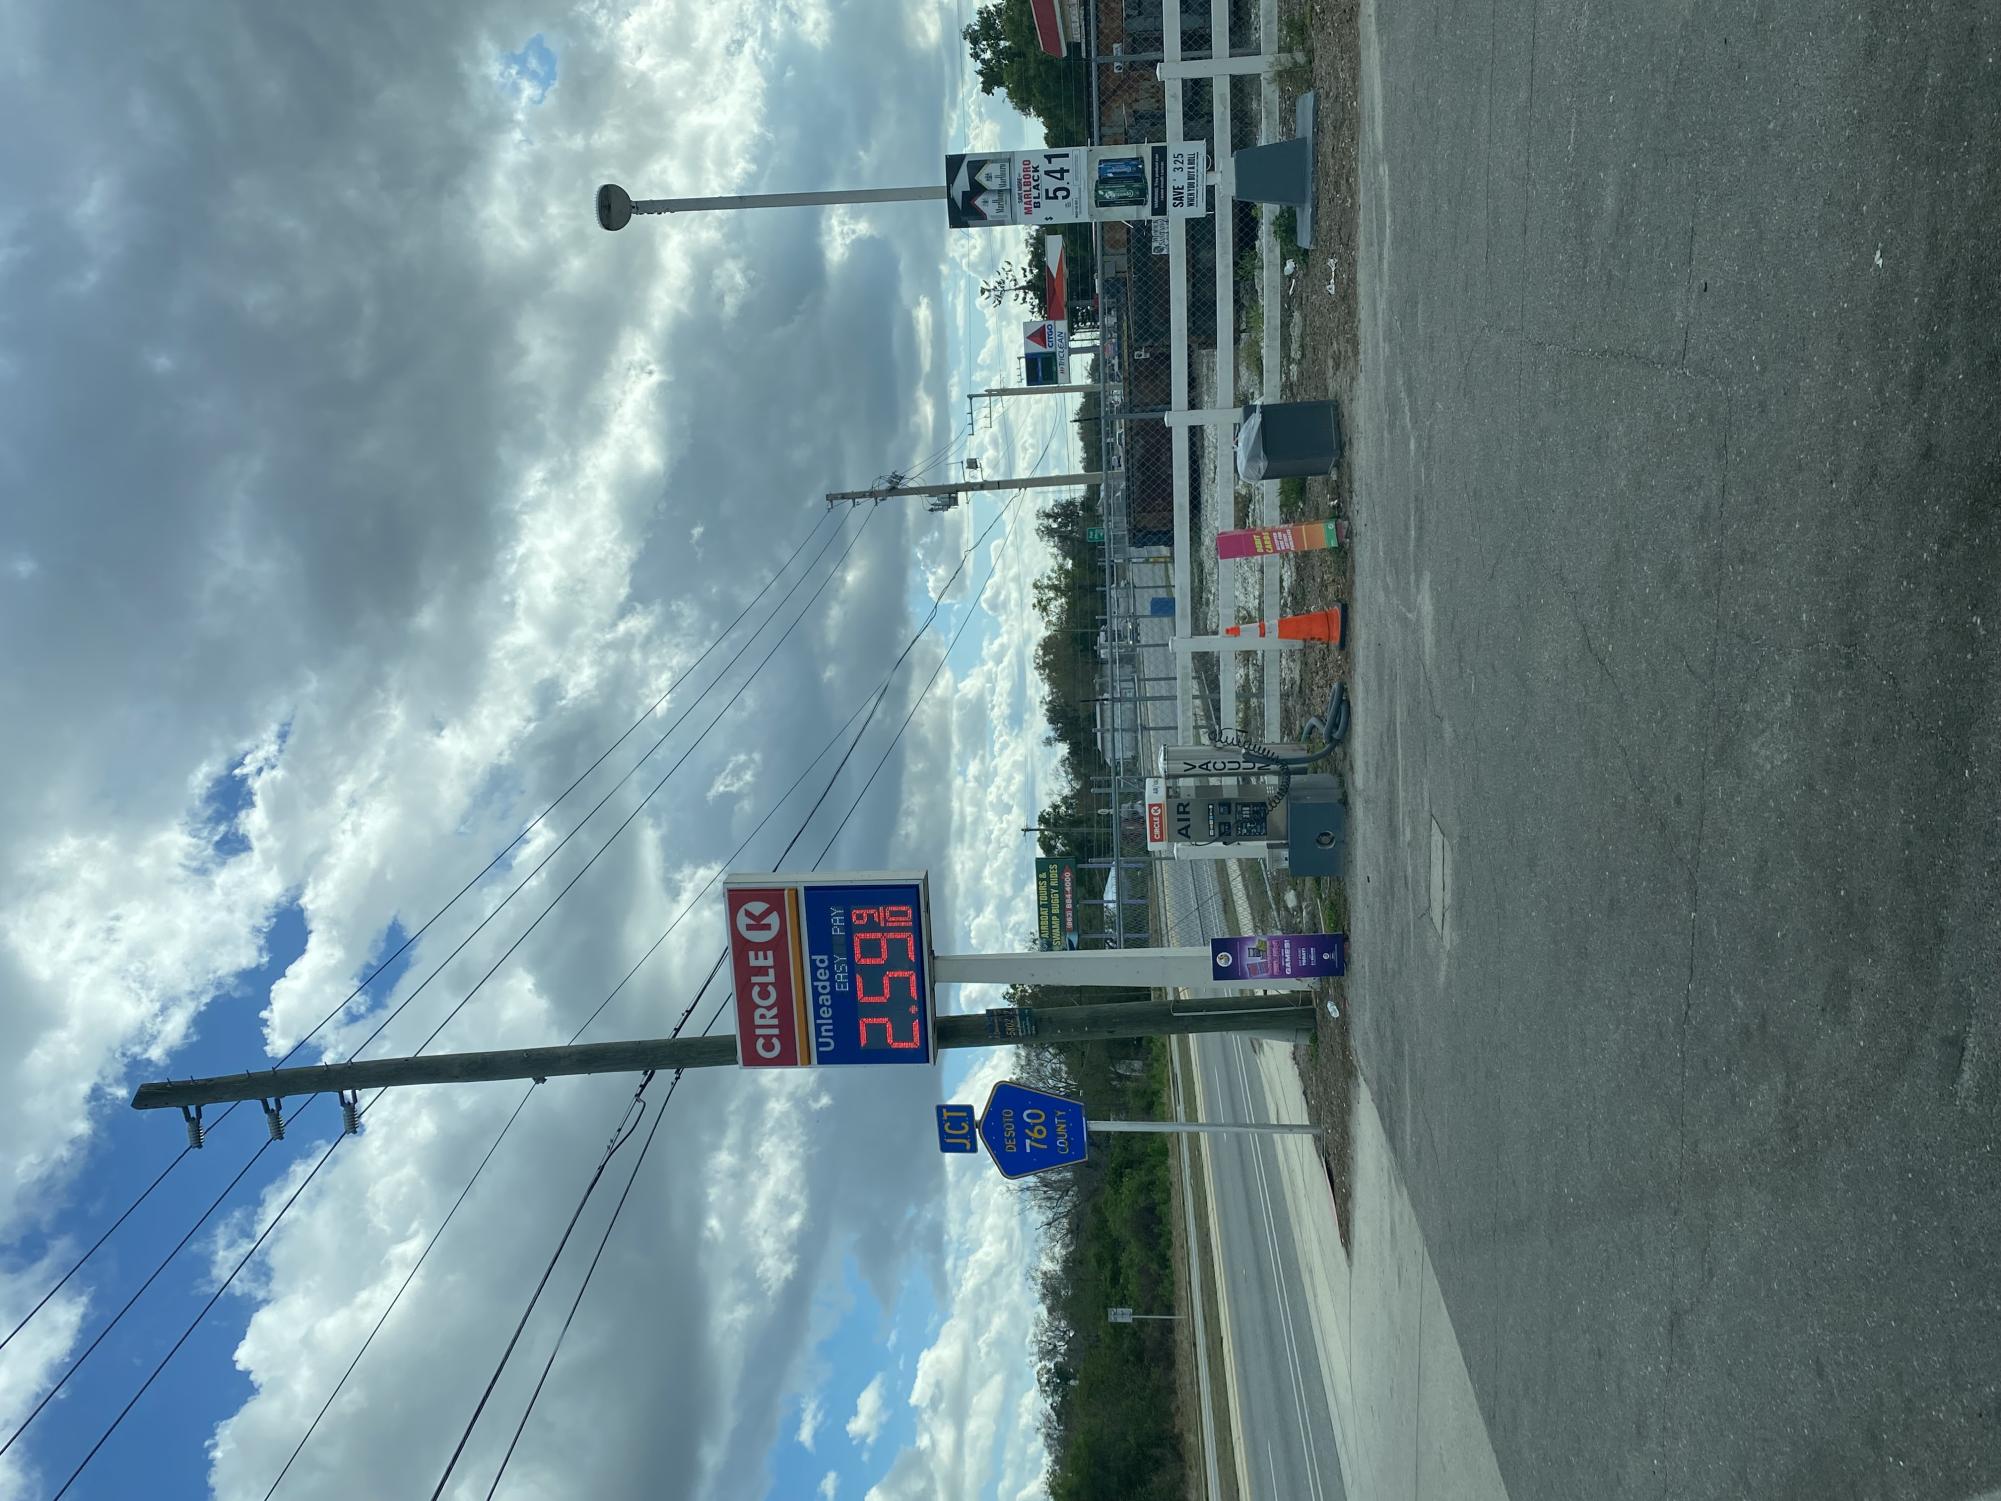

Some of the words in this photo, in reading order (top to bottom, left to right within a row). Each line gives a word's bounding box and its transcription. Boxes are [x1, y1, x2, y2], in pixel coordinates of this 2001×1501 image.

[1186, 171, 1195, 180] BUY
[1187, 152, 1195, 165] ROLL
[1022, 160, 1032, 215] MARLBORO
[1032, 164, 1040, 208] BLACK
[1044, 153, 1070, 200] 5.41
[1186, 182, 1195, 192] YOU
[1172, 185, 1184, 208] SAVE
[1186, 192, 1195, 207] WHEN
[1262, 532, 1273, 553] CARDS
[1177, 802, 1191, 839] AIR
[1039, 880, 1048, 905] TOURS
[1049, 864, 1058, 886] RIDES
[1051, 889, 1059, 914] BUGGY
[830, 906, 846, 934] PAY
[1040, 907, 1049, 938] AIRBOAT
[1052, 916, 1061, 946] SWAMP
[834, 954, 849, 991] EASY
[1284, 940, 1292, 975] GAMES!
[748, 950, 781, 1058] CIRCLE
[812, 954, 834, 1052] Unleaded
[854, 932, 920, 1048] 2.59
[942, 1108, 971, 1150] JCT
[1002, 1109, 1016, 1152] DESOTO
[1022, 1109, 1048, 1152] 760
[1055, 1110, 1069, 1154] COUNTY
